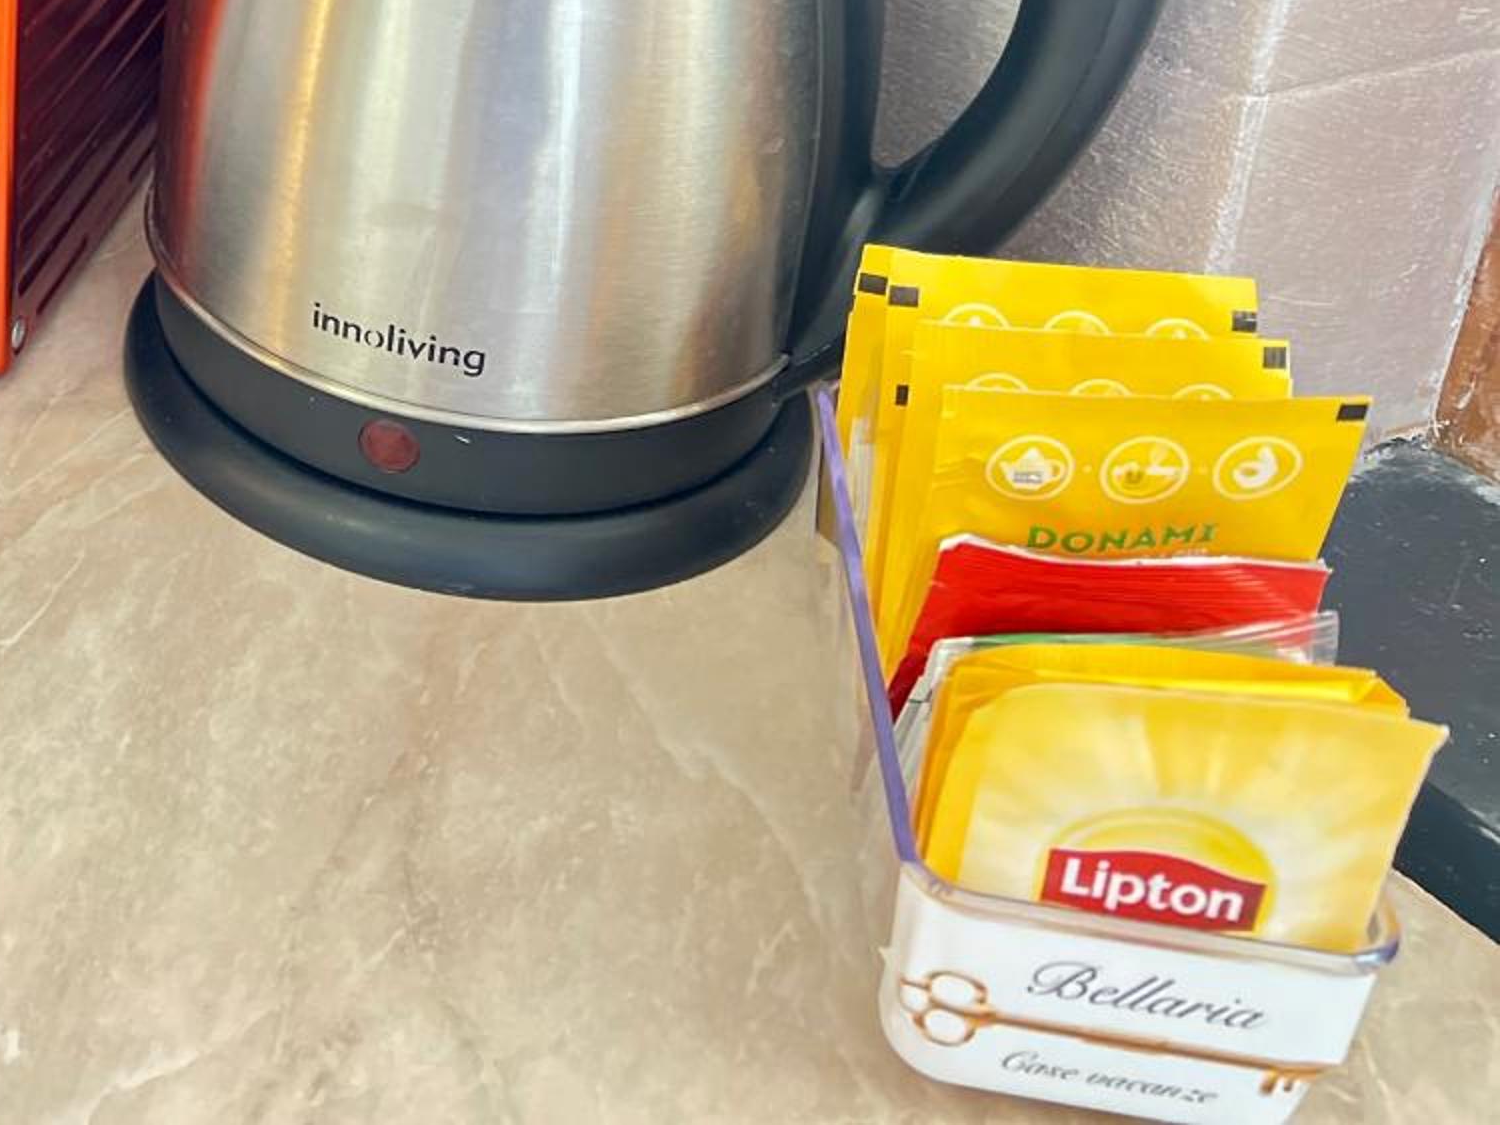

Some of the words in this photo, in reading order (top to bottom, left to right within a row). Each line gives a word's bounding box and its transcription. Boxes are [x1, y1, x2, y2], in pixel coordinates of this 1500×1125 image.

[312, 301, 487, 378] innoliving
[1026, 523, 1218, 554] DONAMI
[1059, 856, 1246, 923] Lipton
[1026, 960, 1266, 1031] Bellaria
[1085, 1071, 1219, 1105] vacanze
